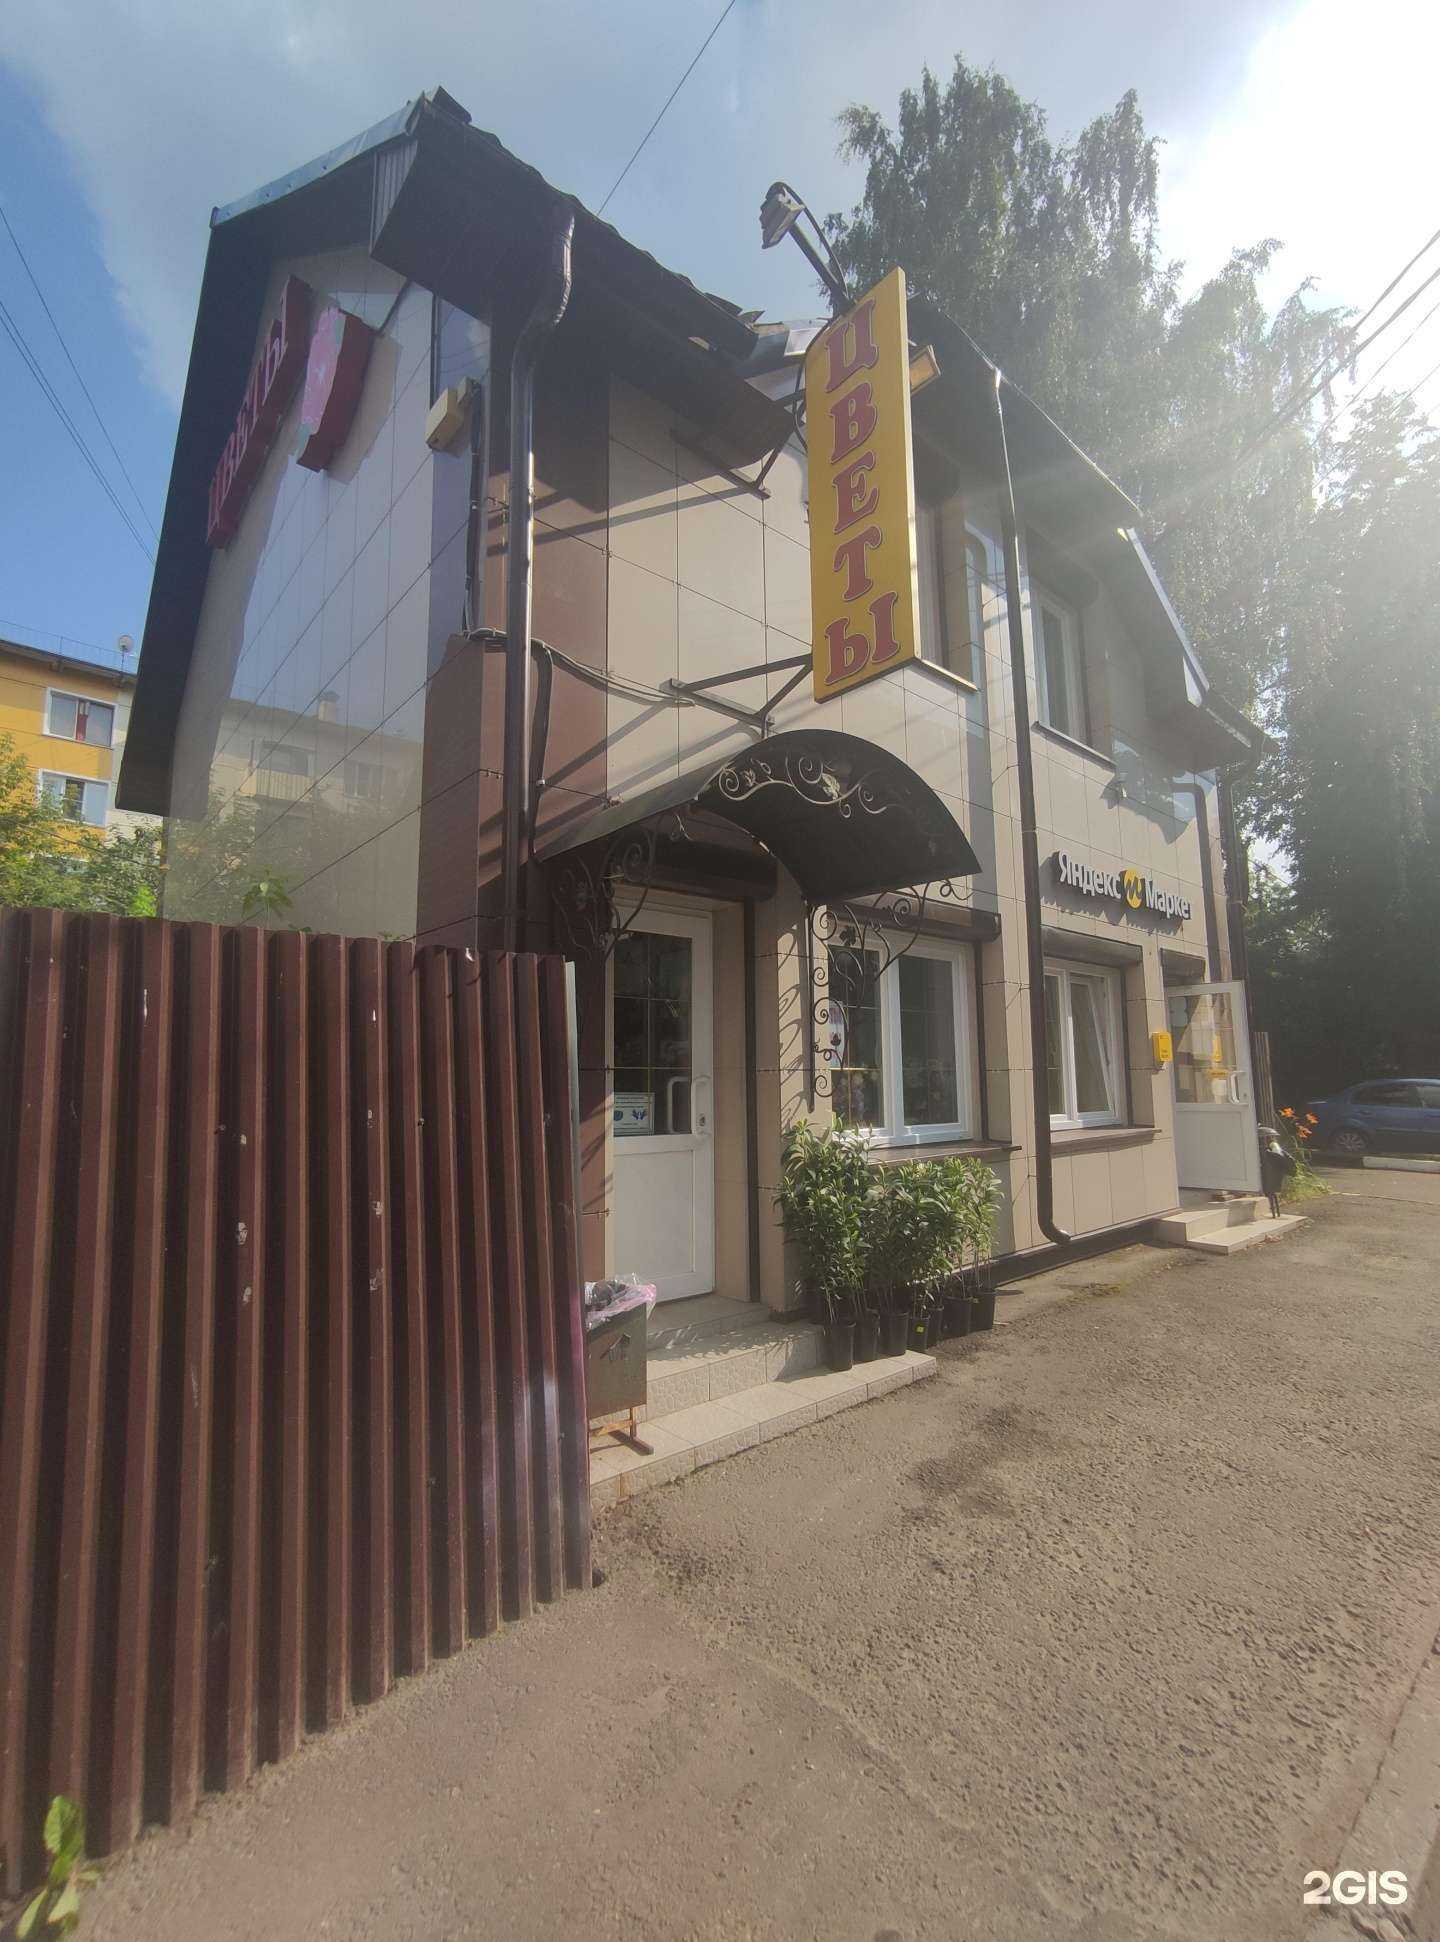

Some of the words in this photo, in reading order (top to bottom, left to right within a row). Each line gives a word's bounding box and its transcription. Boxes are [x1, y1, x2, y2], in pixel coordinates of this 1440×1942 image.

[824, 299, 900, 686] ЦВЕТЫ
[1058, 850, 1122, 899] Яндекс
[1145, 877, 1192, 919] Марке
